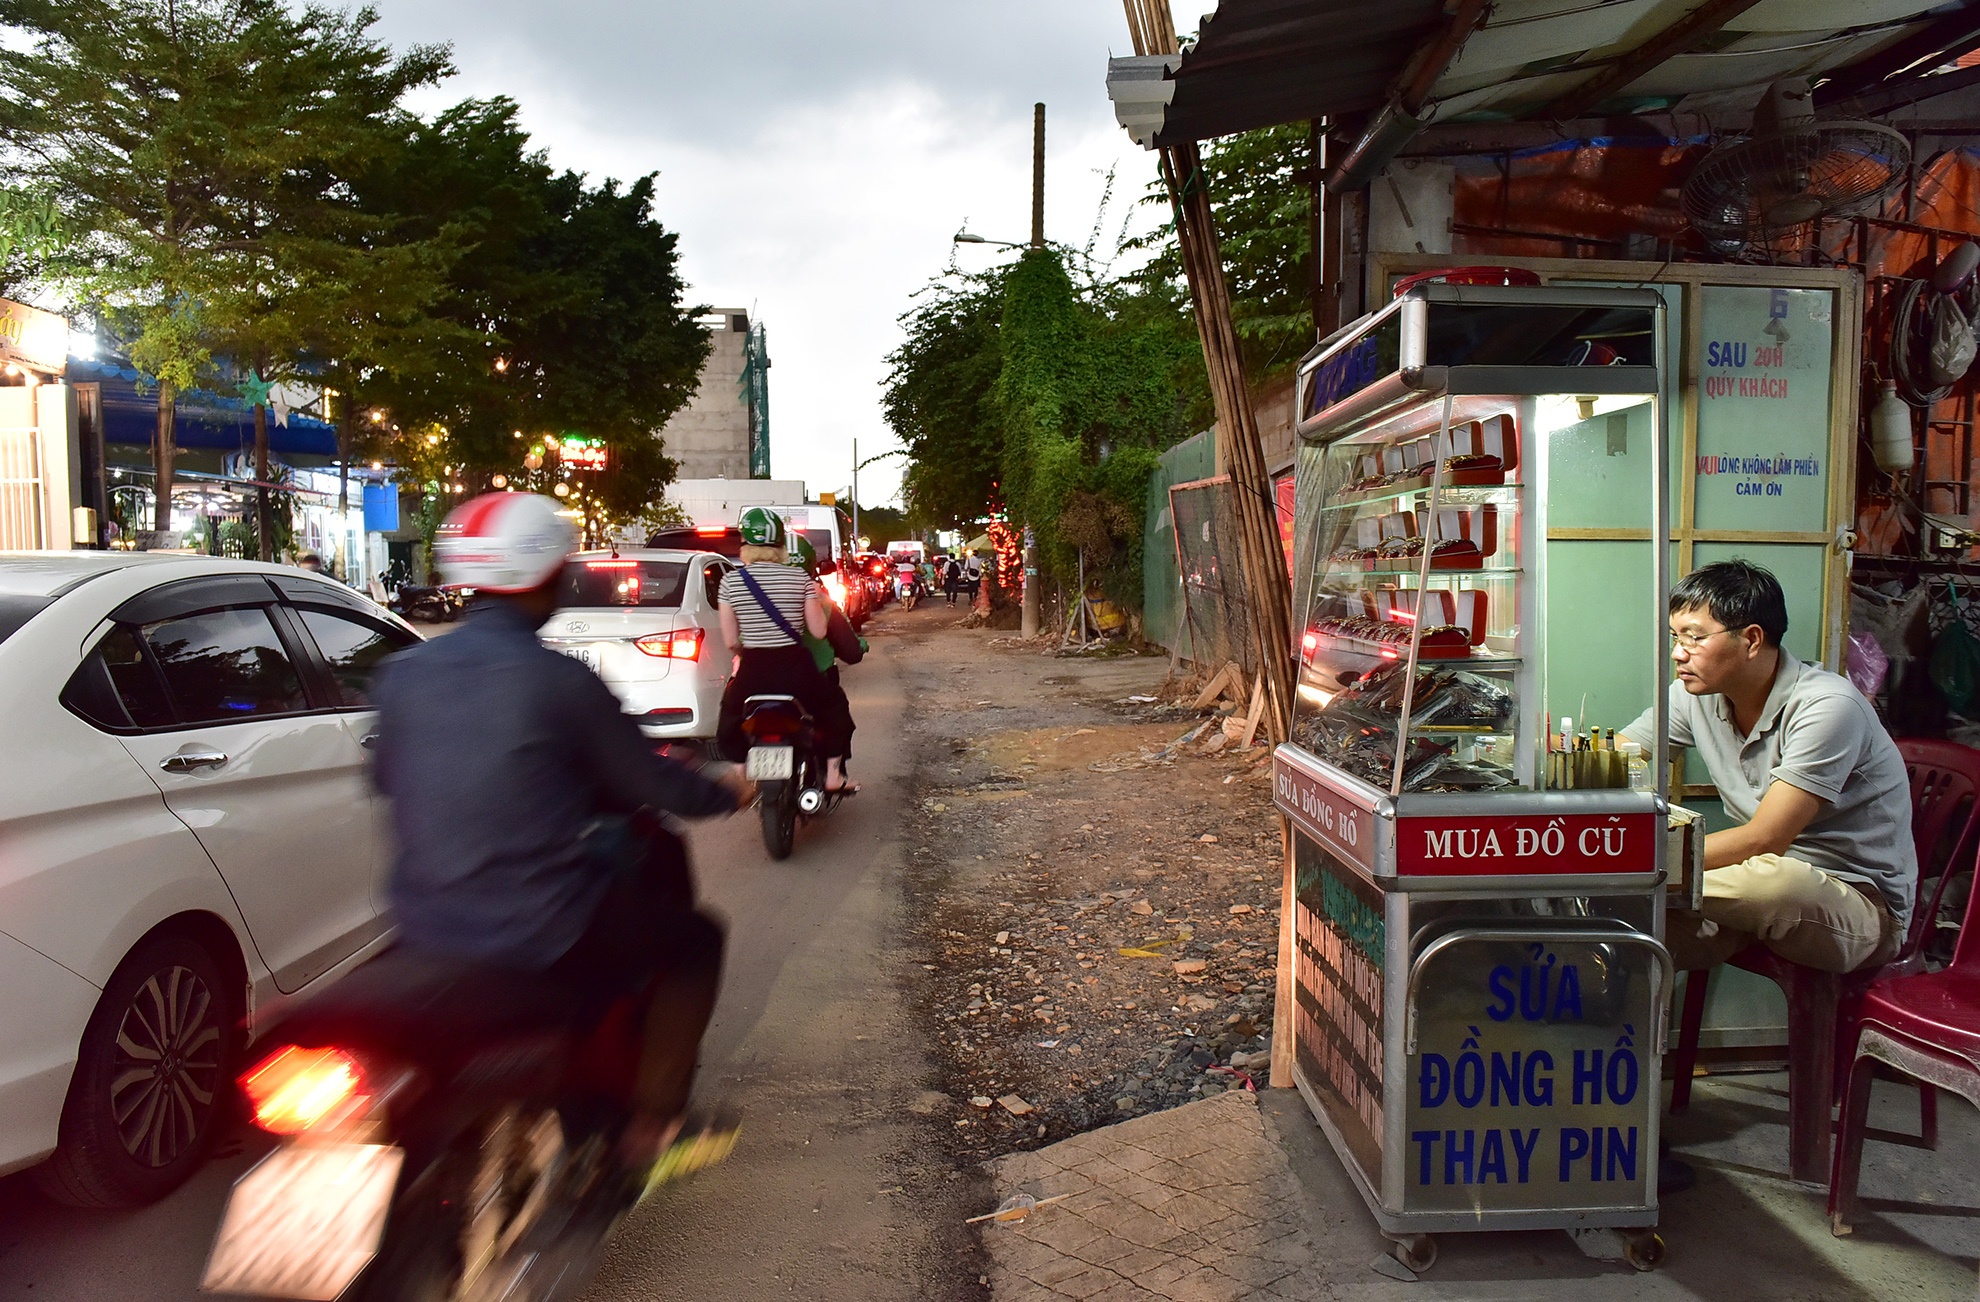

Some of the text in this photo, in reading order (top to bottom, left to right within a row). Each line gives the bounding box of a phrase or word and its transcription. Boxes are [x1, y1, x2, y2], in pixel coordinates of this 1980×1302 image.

[1707, 341, 1747, 367] SAU
[1739, 373, 1788, 398] KHÁCH
[1718, 452, 1740, 473] LÒNG
[1742, 453, 1772, 474] KHÔNG
[1736, 477, 1782, 496] CẢM ƠN
[1279, 767, 1358, 847] SỬA ĐỒNG HỒ
[1424, 816, 1627, 859] MUA ĐỒ CŨ
[1486, 942, 1583, 1022] SỬA
[1418, 1023, 1639, 1108] ĐỒNG HỒ
[1411, 1126, 1638, 1186] THAY PIN
